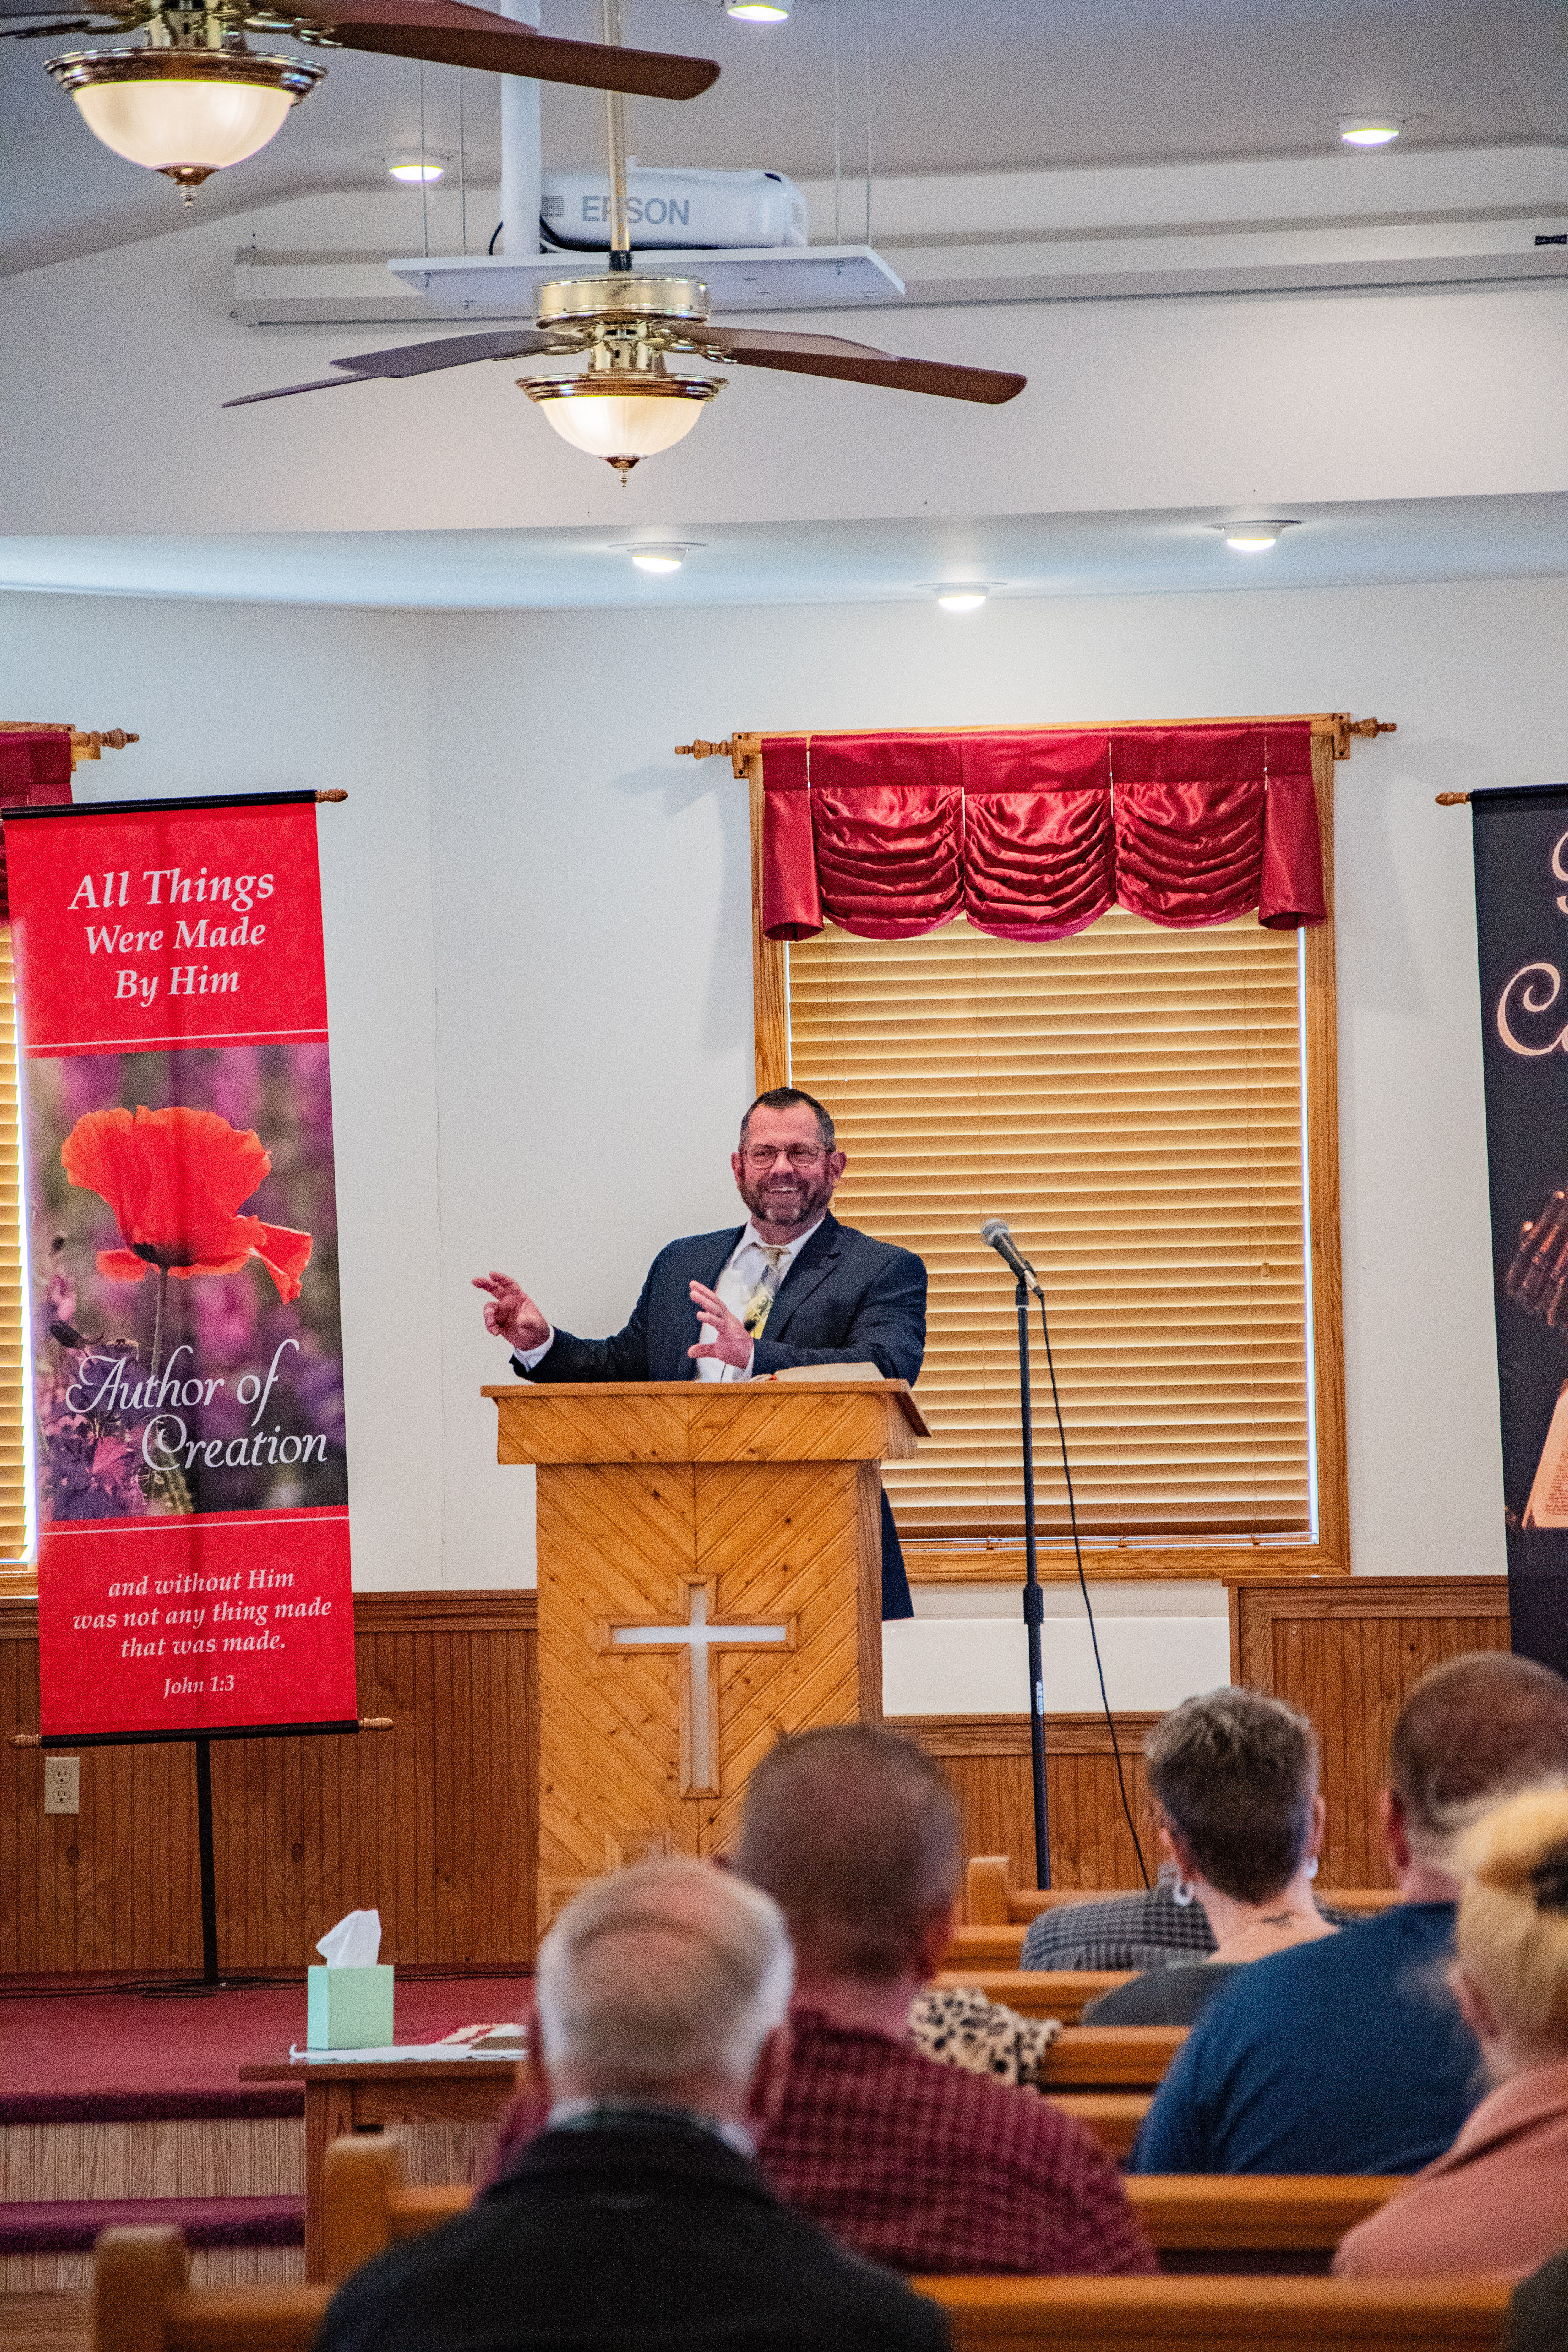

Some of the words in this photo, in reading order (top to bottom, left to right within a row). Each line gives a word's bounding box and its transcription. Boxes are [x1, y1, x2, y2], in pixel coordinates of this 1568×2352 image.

[68, 871, 129, 909] All
[143, 867, 274, 912] Things
[84, 924, 163, 954] Were
[173, 915, 266, 949] Made
[114, 970, 158, 1008] By
[167, 965, 240, 995] Him
[65, 1345, 225, 1413] Author
[237, 1338, 300, 1426] of
[142, 1414, 327, 1472] Creation
[108, 1575, 148, 1598] and
[155, 1572, 242, 1595] without
[247, 1568, 294, 1590] Him
[73, 1614, 117, 1630] was
[123, 1609, 159, 1627] not
[165, 1608, 205, 1629] any
[212, 1601, 269, 1626] thing
[274, 1596, 332, 1618] made
[121, 1637, 166, 1658] that
[172, 1638, 217, 1655] was
[223, 1629, 286, 1652] made.
[163, 1677, 204, 1699] John
[210, 1674, 235, 1692] 1:3
